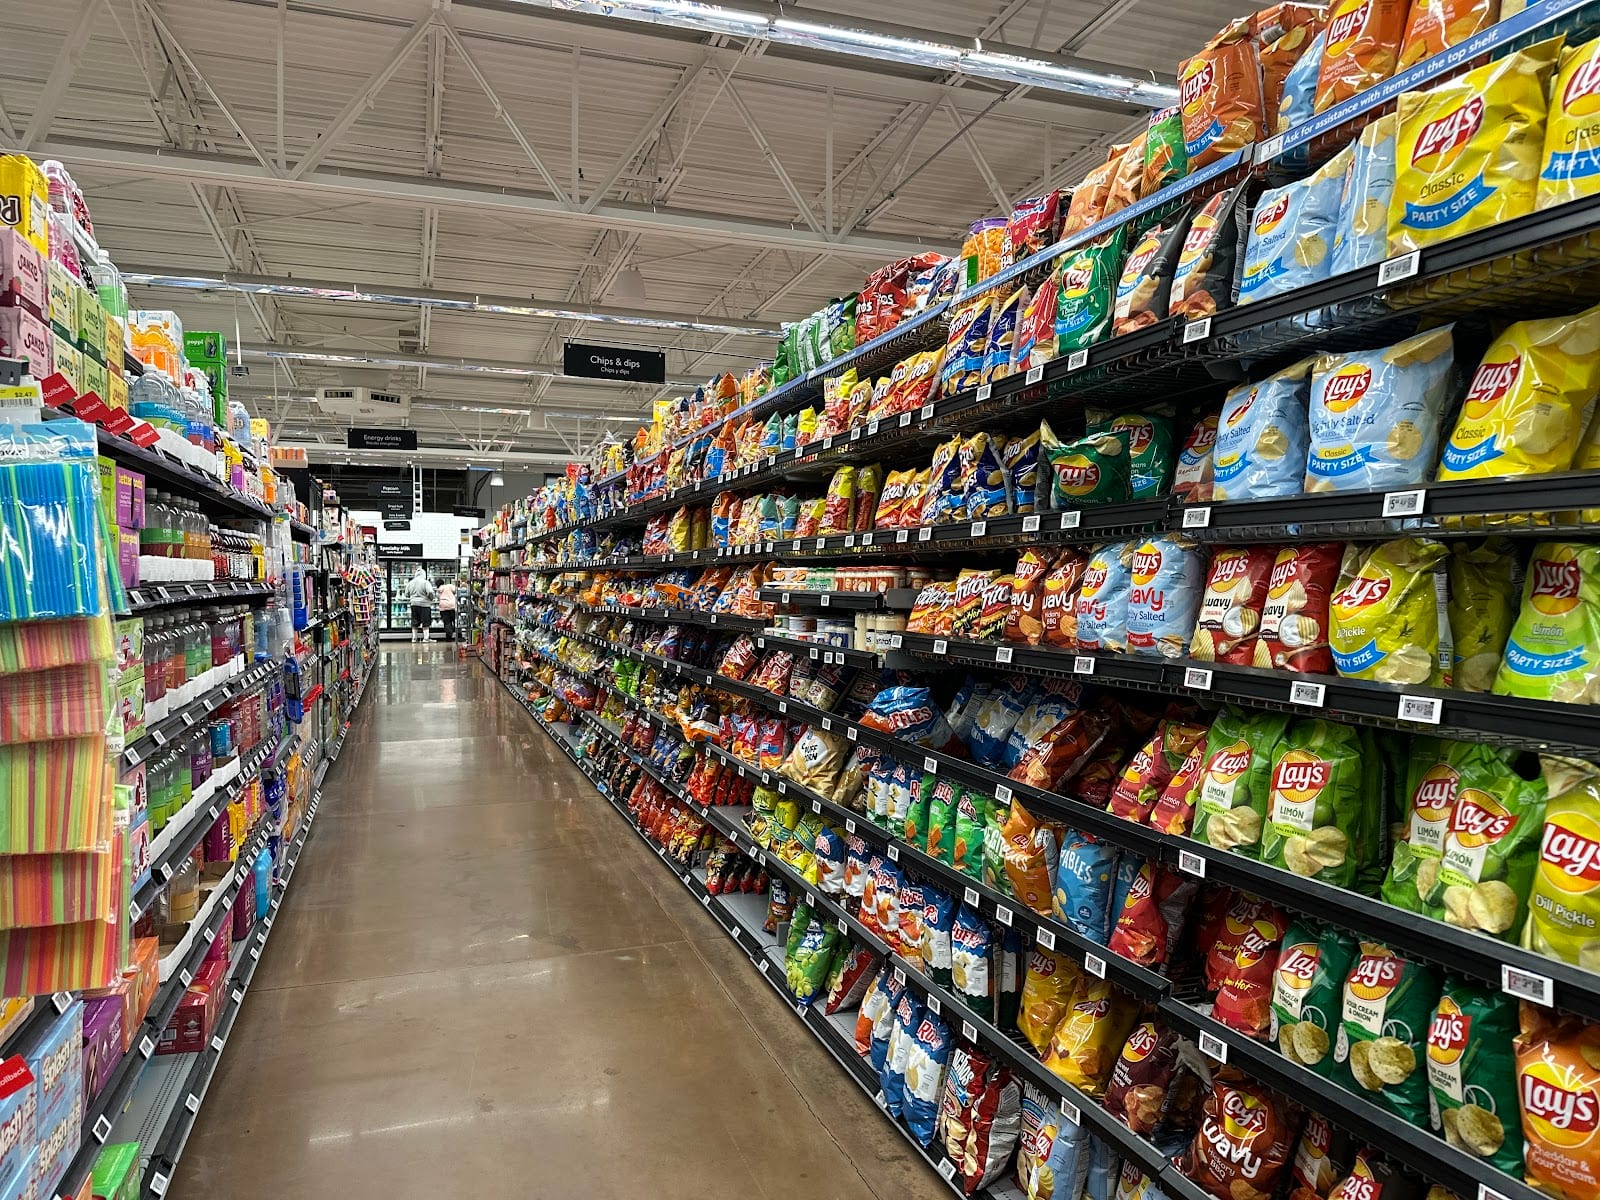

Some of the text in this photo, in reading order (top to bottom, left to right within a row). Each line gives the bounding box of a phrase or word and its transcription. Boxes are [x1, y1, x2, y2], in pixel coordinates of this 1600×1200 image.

[1327, 2, 1368, 45] Lay's
[1284, 29, 1498, 146] Ask for assistance with items on the top shelf.
[1413, 101, 1481, 161] Lay's
[1186, 142, 1200, 154] ARTY
[1552, 155, 1599, 172] PARTY
[1172, 179, 1193, 193] estante
[1420, 172, 1464, 199] Classic
[1412, 188, 1478, 222] PARTY SIZE
[1263, 230, 1287, 246] Salted
[18, 254, 38, 282] SANZO
[1241, 276, 1257, 289] ARTY
[1021, 316, 1038, 333] avy
[24, 333, 45, 358] SANZO
[57, 355, 73, 377] SANZO
[590, 355, 640, 369] Chips & dips
[601, 366, 615, 374] Chips
[44, 383, 69, 399] Rollback
[1326, 372, 1368, 402] Lay's
[1467, 361, 1517, 402] Lay's
[80, 400, 103, 416] Rollback
[107, 414, 129, 430] Rollback
[363, 434, 384, 442] Energy
[1230, 426, 1251, 440] Salted
[1456, 426, 1486, 441] Classic
[1324, 449, 1347, 458] Classic
[1446, 446, 1487, 465] PARTY SIZE
[1229, 460, 1243, 473] SIZE
[1312, 455, 1364, 473] PARTY SIZE
[881, 484, 905, 501] ritos
[380, 545, 399, 553] Specialty
[1212, 556, 1248, 584] Lay's
[955, 572, 991, 603] Fritos
[982, 586, 1012, 609] Frito
[1011, 590, 1034, 611] avy
[1085, 621, 1107, 630] Salted
[1140, 610, 1165, 622] Salted
[1343, 626, 1366, 637] Pickle
[1532, 623, 1564, 636] Limón
[1353, 650, 1373, 666] SIZE
[1508, 649, 1573, 669] PARTY SIZE
[1211, 751, 1249, 775] Lay's
[1277, 762, 1324, 791] Lay's
[1207, 786, 1226, 798] LIMÓN
[1417, 777, 1457, 809] Lay's
[1280, 804, 1304, 819] LIMÓN
[1455, 798, 1509, 834] Lay's
[1417, 826, 1440, 840] LIMÓN
[1536, 894, 1596, 928] Dill Pickle
[1281, 949, 1317, 980] Lay
[1351, 956, 1396, 987] ay's
[1353, 1009, 1371, 1022] ONION
[1358, 1004, 1379, 1018] CREAM
[1429, 1014, 1464, 1049] ay's
[0, 1066, 27, 1088] ollback
[953, 1051, 975, 1086] NCHOS
[1437, 1068, 1458, 1083] CREAM
[1524, 1075, 1595, 1129] Lay's
[1207, 1147, 1235, 1177] Hickory
[1533, 1143, 1591, 1173] Cheddar &
[1209, 1160, 1226, 1179] BBQ
[1531, 1152, 1597, 1185] Sour Cream
[1343, 1176, 1374, 1200] ay's
